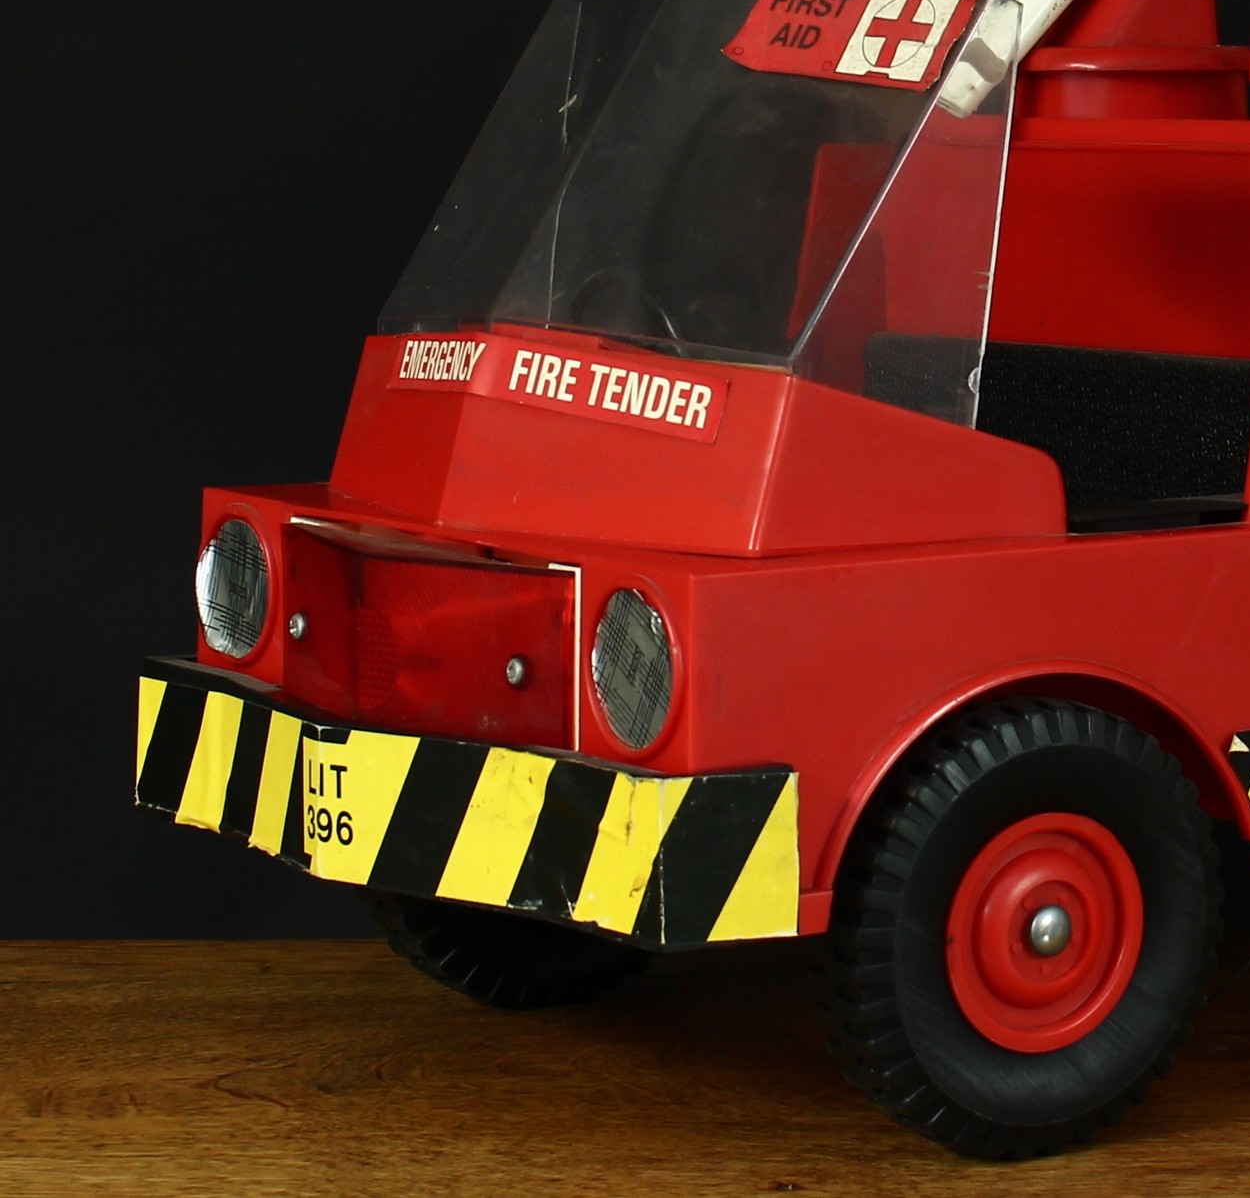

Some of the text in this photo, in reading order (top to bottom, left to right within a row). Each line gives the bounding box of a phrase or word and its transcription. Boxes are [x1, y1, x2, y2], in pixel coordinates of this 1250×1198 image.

[769, 22, 822, 50] AID
[398, 340, 487, 381] EMERGENCY
[508, 349, 713, 429] FIRE TENDER
[308, 759, 348, 799] LIT
[307, 805, 354, 846] 396
